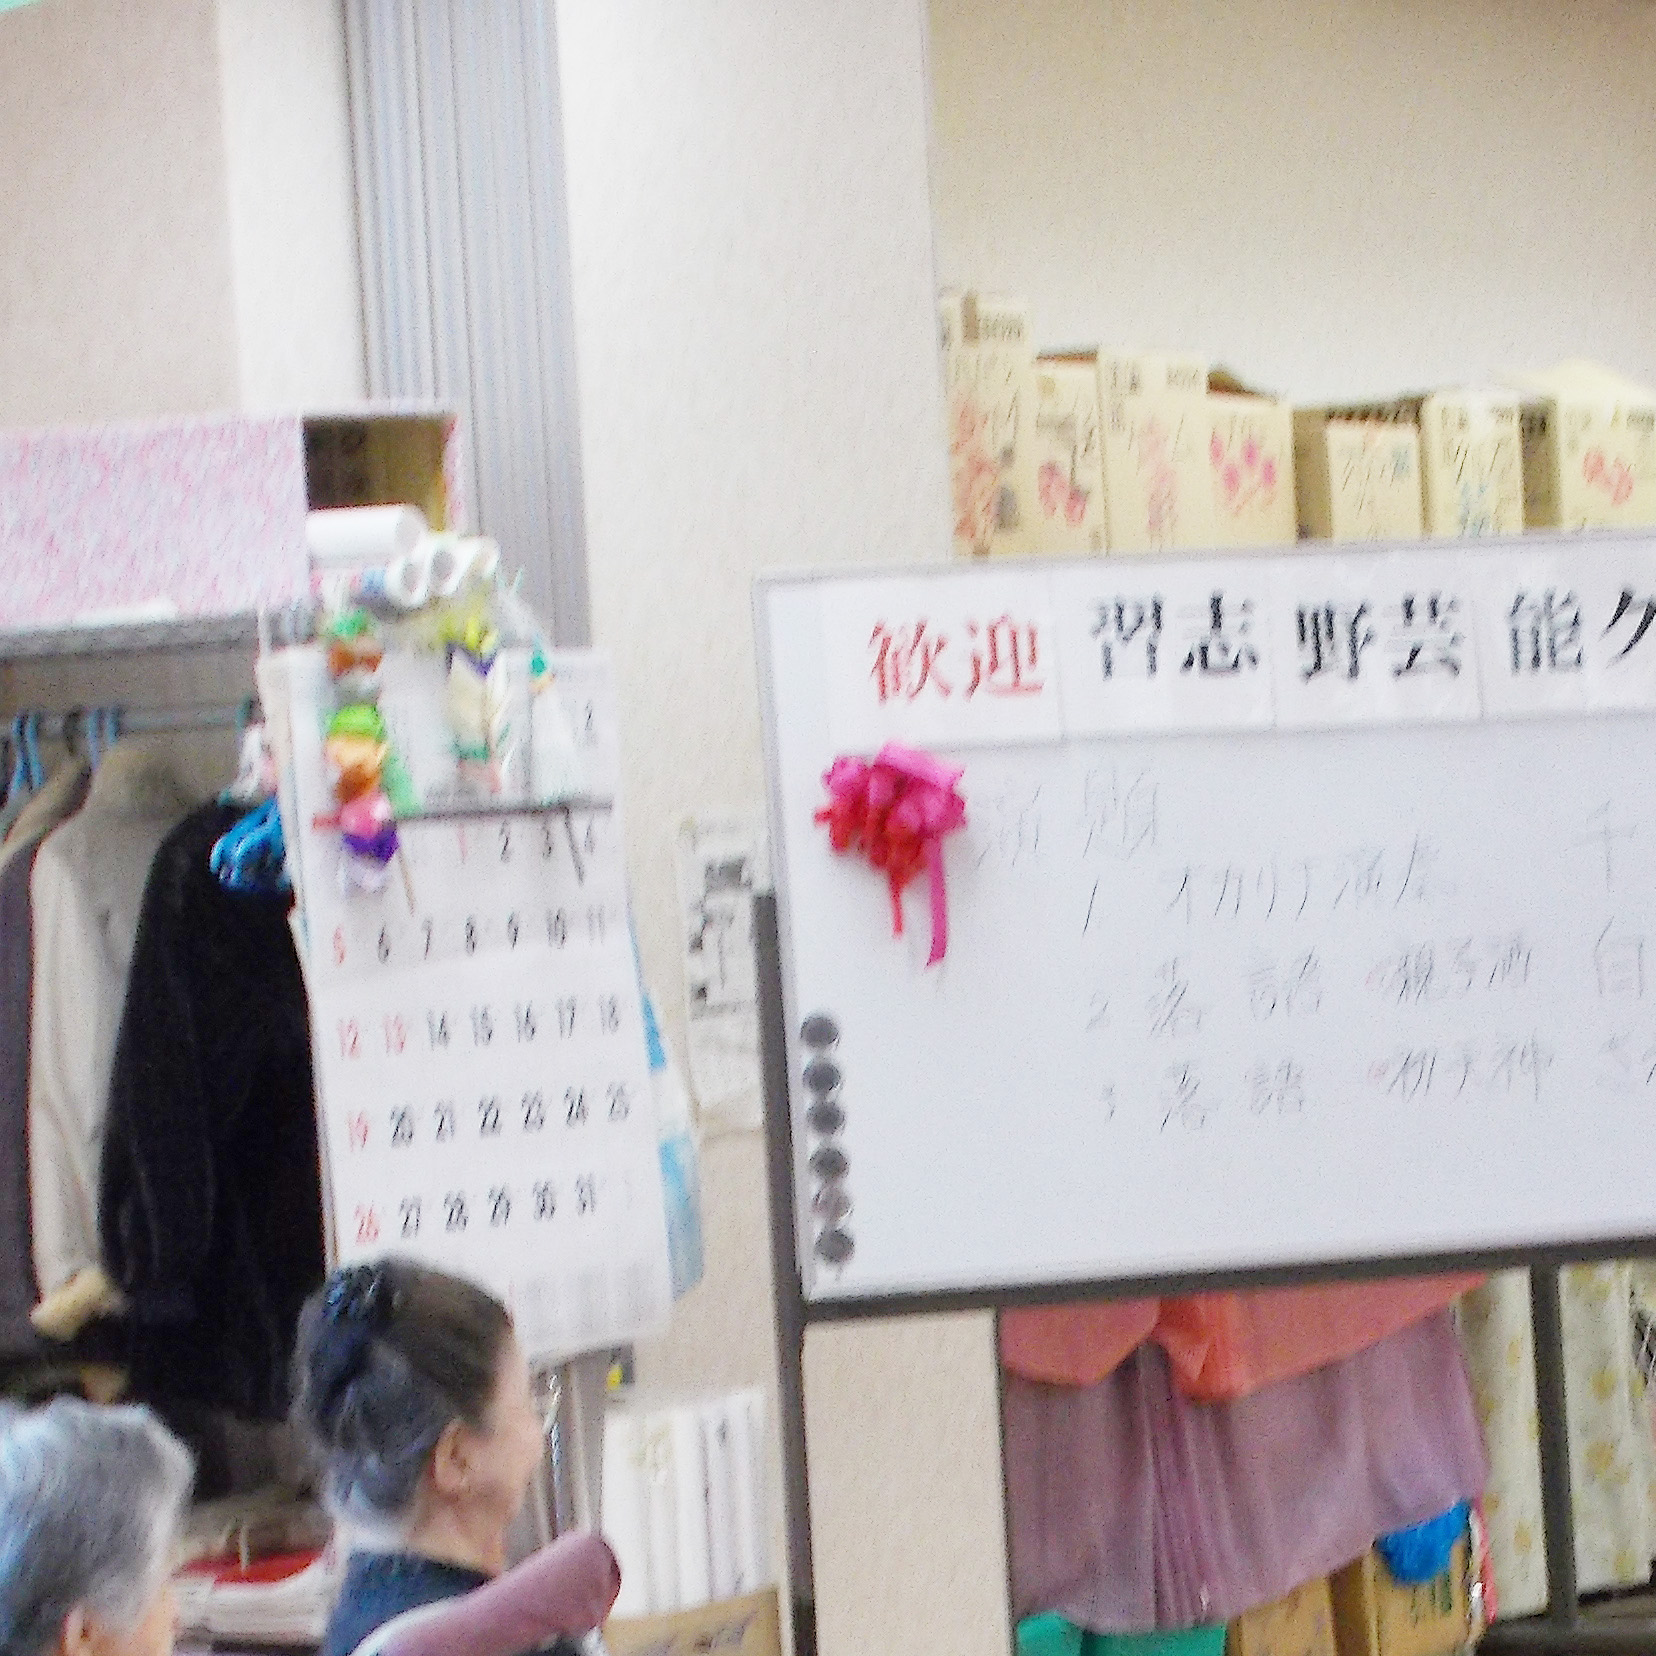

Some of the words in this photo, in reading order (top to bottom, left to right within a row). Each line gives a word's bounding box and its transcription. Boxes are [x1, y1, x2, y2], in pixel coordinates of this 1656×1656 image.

[868, 611, 1044, 704] 歓迎
[377, 923, 391, 965] 6
[421, 917, 434, 961] 7
[464, 914, 477, 957] 8
[507, 911, 520, 951] 9
[546, 907, 568, 950] 10
[337, 1016, 361, 1061] 12
[427, 1008, 450, 1051] 14
[470, 1004, 493, 1047] 15
[514, 1000, 537, 1043] 16
[557, 995, 577, 1040] 17
[600, 992, 620, 1036] 18
[348, 1109, 369, 1152] 19
[389, 1104, 415, 1149] 20
[434, 1100, 455, 1143] 21
[478, 1095, 501, 1138] 22
[521, 1090, 546, 1133] 23
[563, 1085, 588, 1128] 24
[605, 1081, 631, 1122] 25
[354, 1202, 380, 1246] 26
[400, 1195, 422, 1239] 27
[443, 1189, 469, 1233] 28
[488, 1183, 511, 1227] 29
[532, 1177, 556, 1222] 30
[575, 1172, 596, 1217] 31
